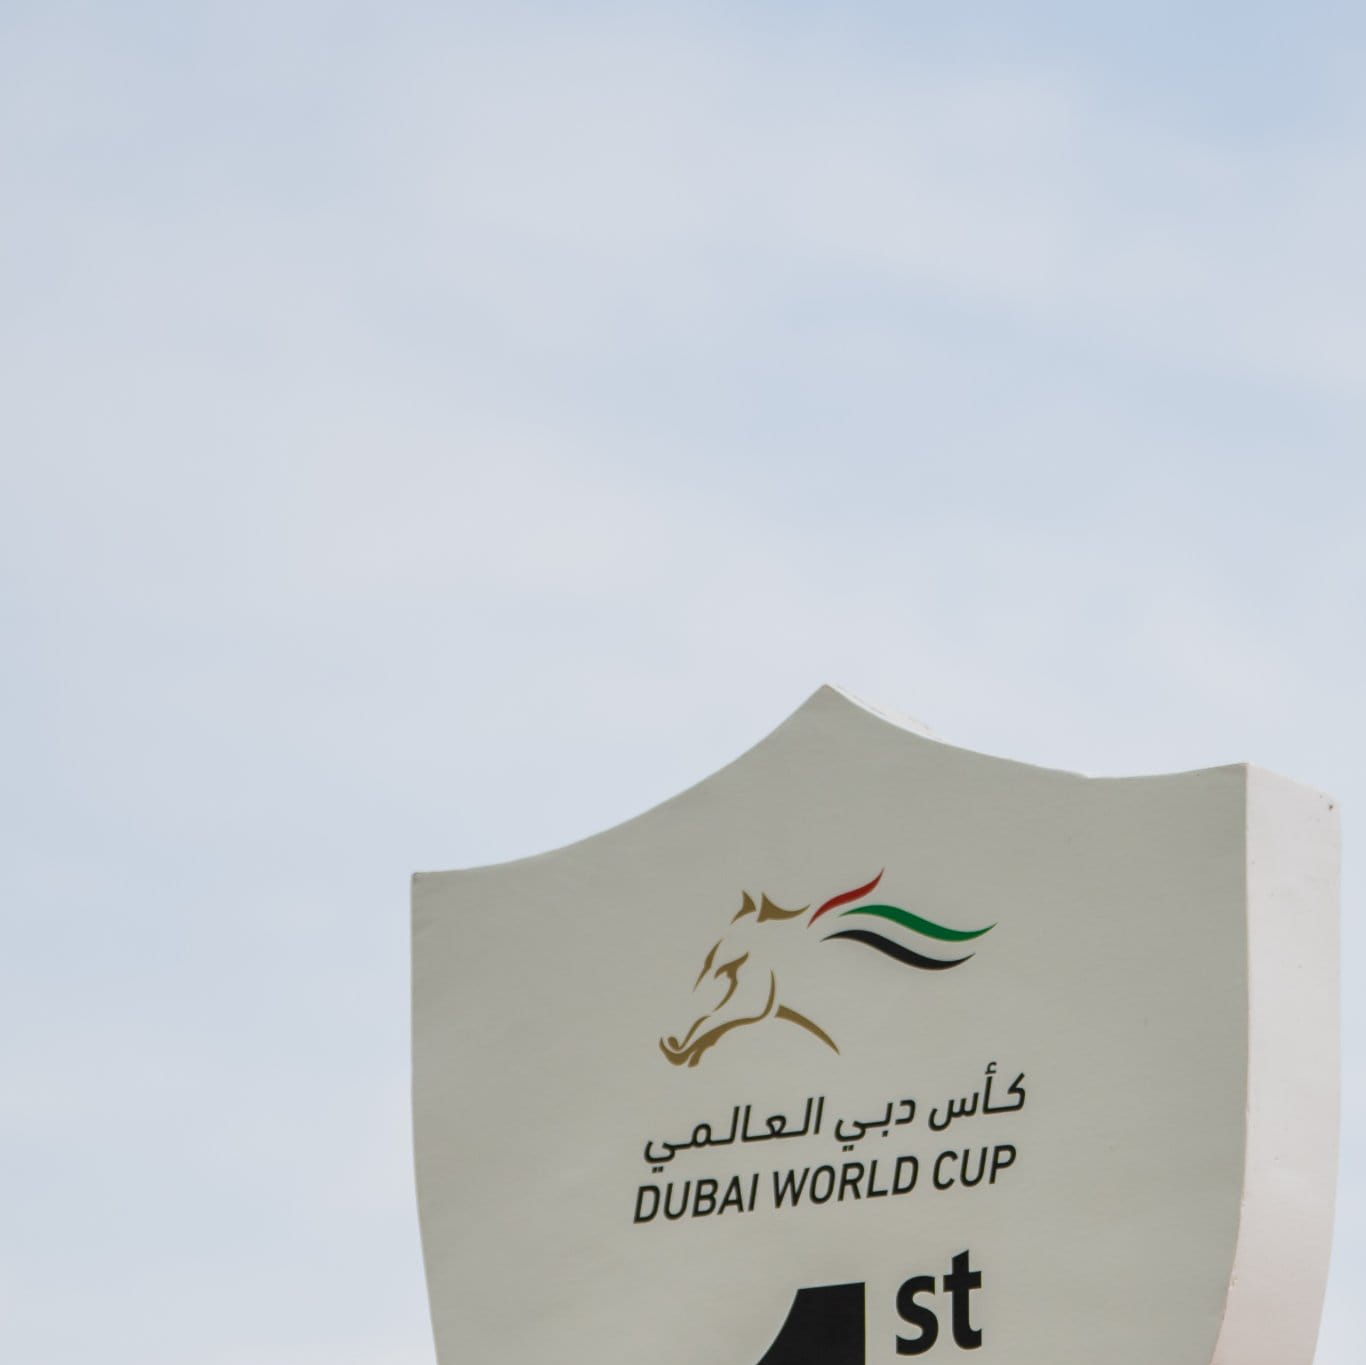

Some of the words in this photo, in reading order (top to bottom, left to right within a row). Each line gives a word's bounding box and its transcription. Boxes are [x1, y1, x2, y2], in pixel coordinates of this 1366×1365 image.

[834, 1099, 916, 1152] دبي
[929, 1062, 1026, 1131] كأس
[643, 1096, 825, 1172] العالمي
[633, 1173, 759, 1224] DUBAI
[772, 1155, 919, 1208] WORLD
[932, 1145, 1017, 1191] CUP
